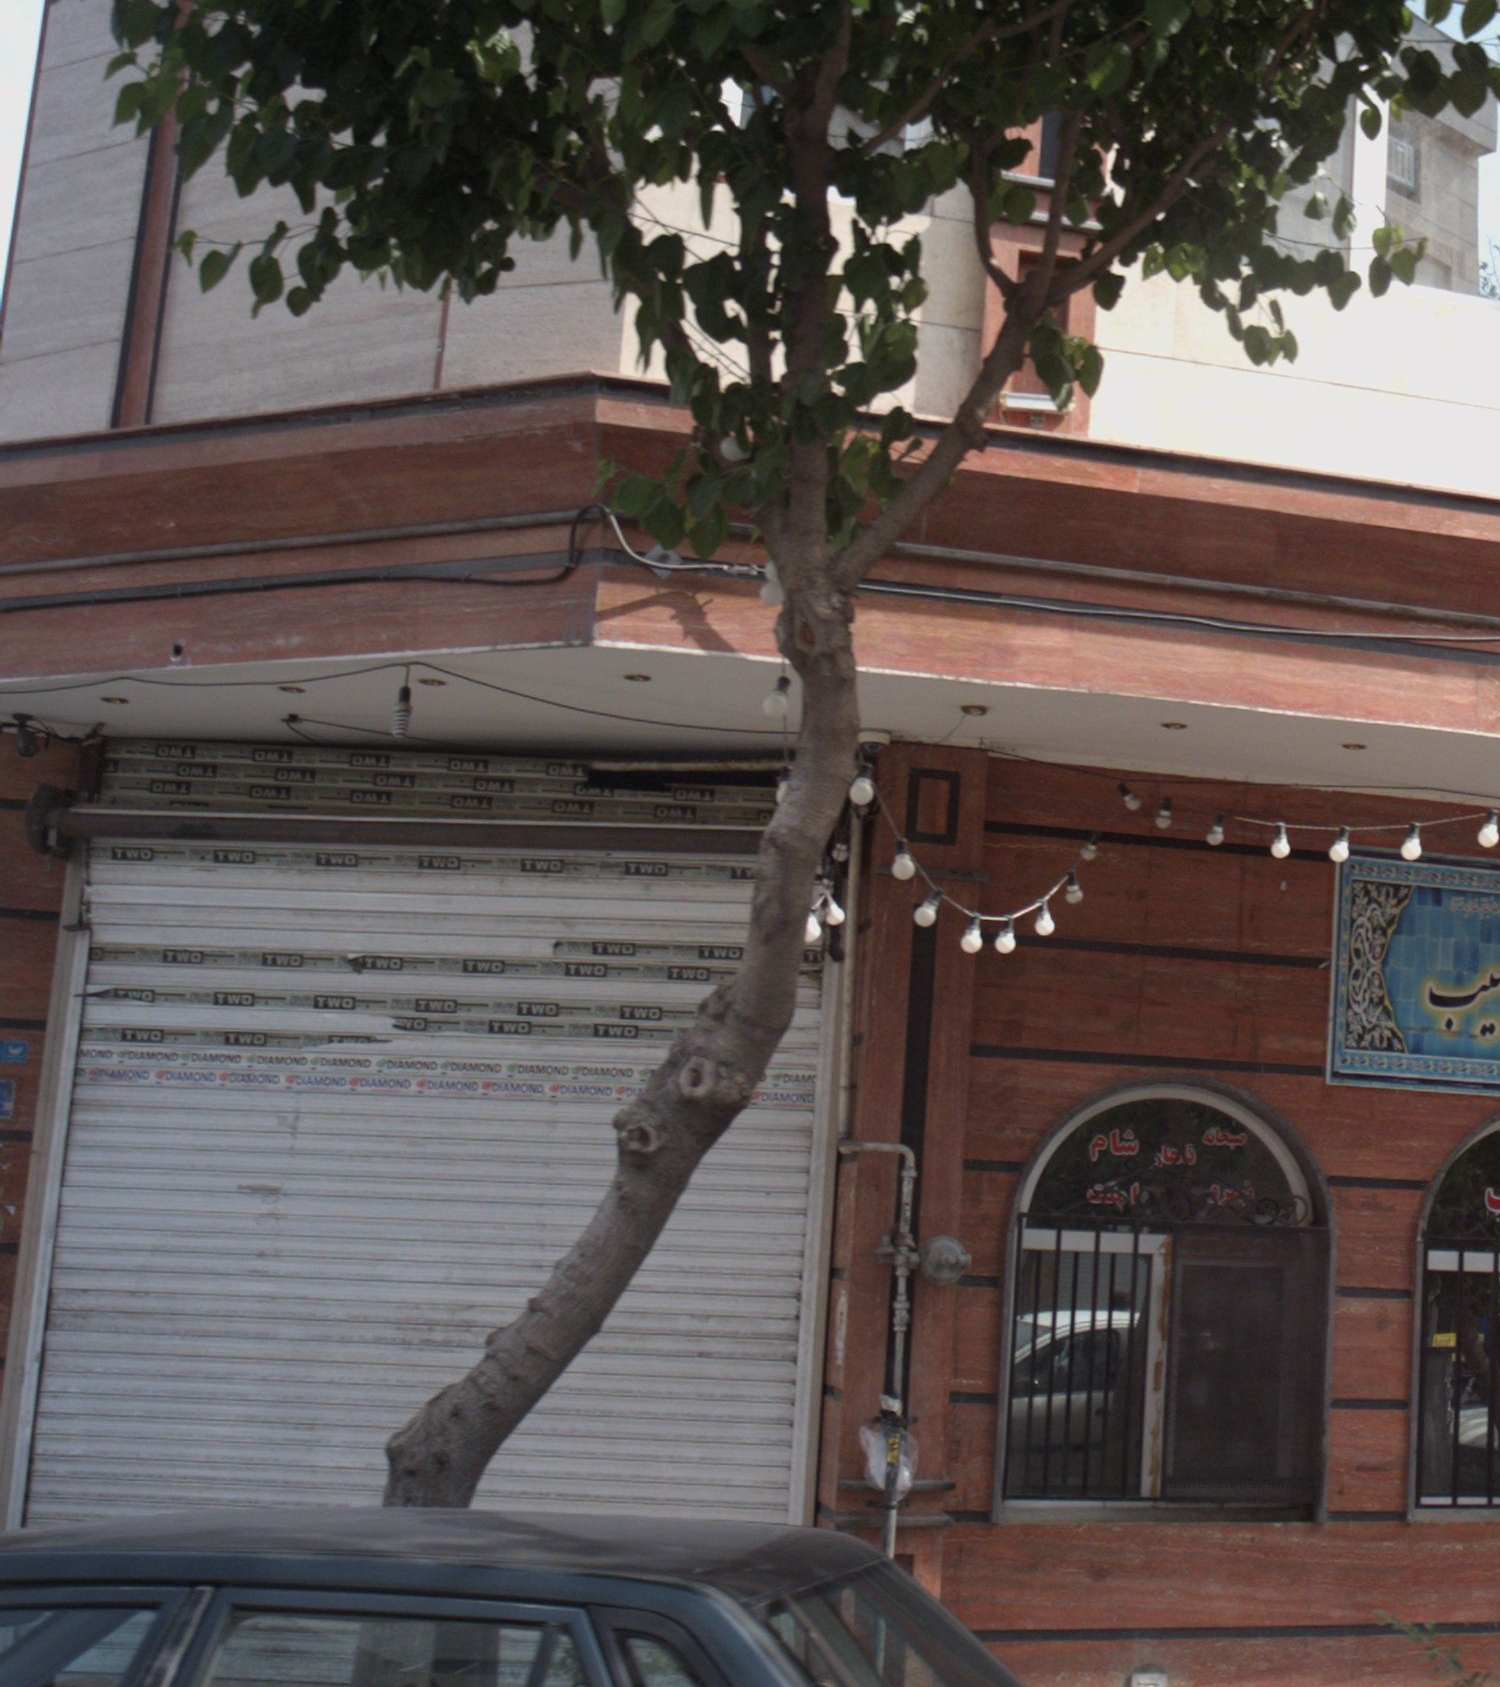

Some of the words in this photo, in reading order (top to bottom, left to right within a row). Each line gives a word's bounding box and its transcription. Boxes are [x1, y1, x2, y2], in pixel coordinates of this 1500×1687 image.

[115, 849, 151, 860] TWO
[216, 852, 253, 863] TWO
[319, 854, 357, 866] TWO
[422, 857, 459, 868] TWO
[523, 860, 562, 872] TWO
[627, 864, 667, 875] TWO
[595, 943, 635, 955] TWO
[703, 947, 742, 959] TWO
[164, 951, 202, 963] TWO
[264, 955, 302, 967] TWO
[366, 958, 402, 970] TWO
[465, 961, 503, 973] TWO
[567, 964, 606, 977] TWO
[670, 968, 709, 980] TWO
[216, 994, 254, 1005] TWO
[316, 997, 354, 1009] TWO
[418, 1000, 456, 1013] TWO
[520, 1004, 558, 1016] TWO
[623, 1007, 661, 1019] TWO
[123, 1030, 162, 1042] TWO
[226, 1033, 265, 1045] TWO
[491, 1022, 530, 1034] TWO
[597, 1025, 637, 1037] TWO
[80, 1049, 114, 1061] MOND
[128, 1051, 179, 1063] DIAMOND
[190, 1053, 242, 1064] DIAMOND
[257, 1055, 308, 1067] DIAMOND
[320, 1057, 371, 1068] DIAMOND
[386, 1059, 438, 1071] DIAMOND
[450, 1062, 501, 1073] DIAMOND
[517, 1065, 570, 1076] DIAMOND
[581, 1067, 634, 1078] DIAMOND
[164, 1071, 216, 1082] DIAMOND
[228, 1073, 281, 1085] DIAMOND
[294, 1075, 347, 1087] DIAMOND
[359, 1077, 412, 1089] DIAMOND
[427, 1080, 479, 1092] DIAMOND
[491, 1083, 544, 1094] DIAMOND
[560, 1085, 613, 1097] DIAMOND
[761, 1091, 816, 1103] DIAMOND
[1089, 1128, 1140, 1162] شام
